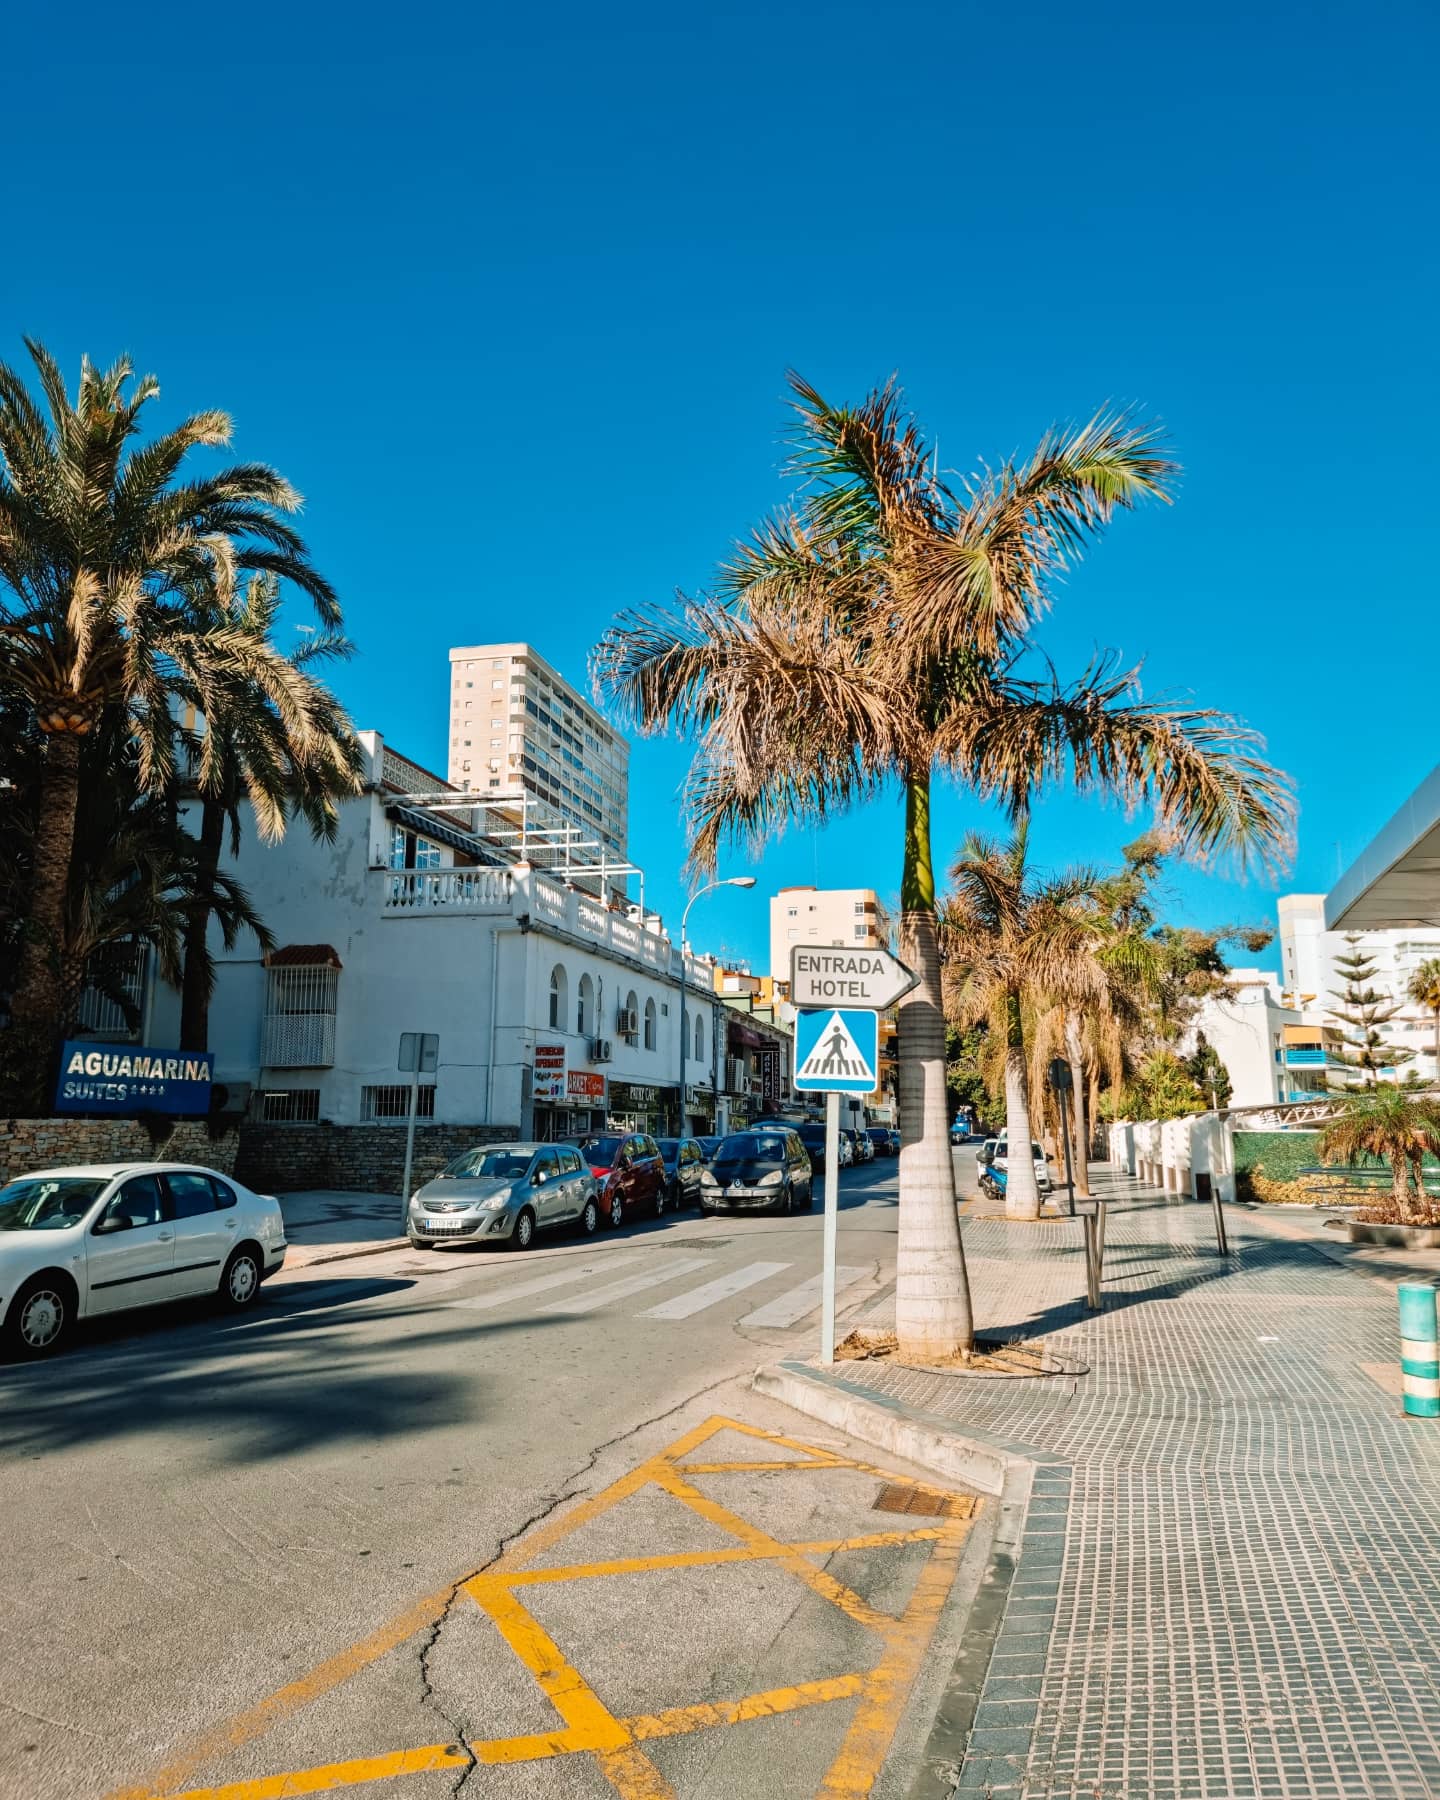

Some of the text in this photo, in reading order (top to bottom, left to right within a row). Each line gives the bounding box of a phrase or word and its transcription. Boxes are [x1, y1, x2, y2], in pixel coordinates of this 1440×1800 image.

[798, 956, 884, 975] ENTRADA
[810, 979, 871, 998] HOTEL
[67, 1051, 211, 1082] AGUAMARINA
[63, 1081, 128, 1101] SUITES
